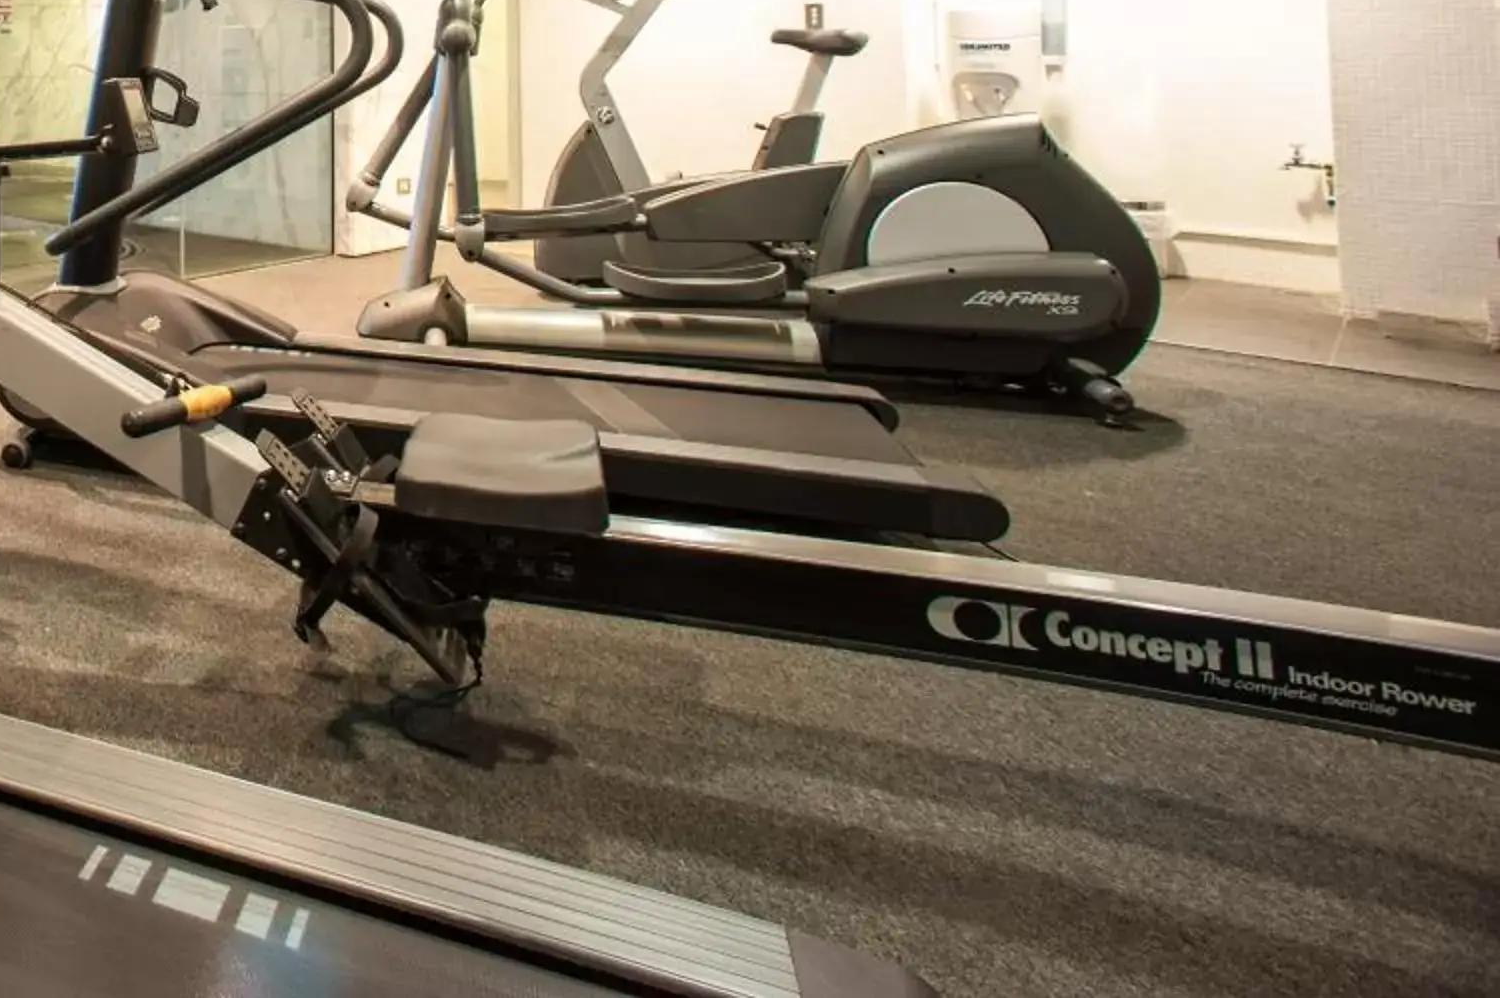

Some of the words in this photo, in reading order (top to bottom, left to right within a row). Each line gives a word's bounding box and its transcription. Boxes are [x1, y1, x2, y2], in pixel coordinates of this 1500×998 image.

[1044, 609, 1224, 674] Concept
[1288, 665, 1375, 697] Indoor
[1381, 681, 1477, 715] Rower
[1201, 670, 1231, 689] The
[1233, 679, 1318, 702] complete
